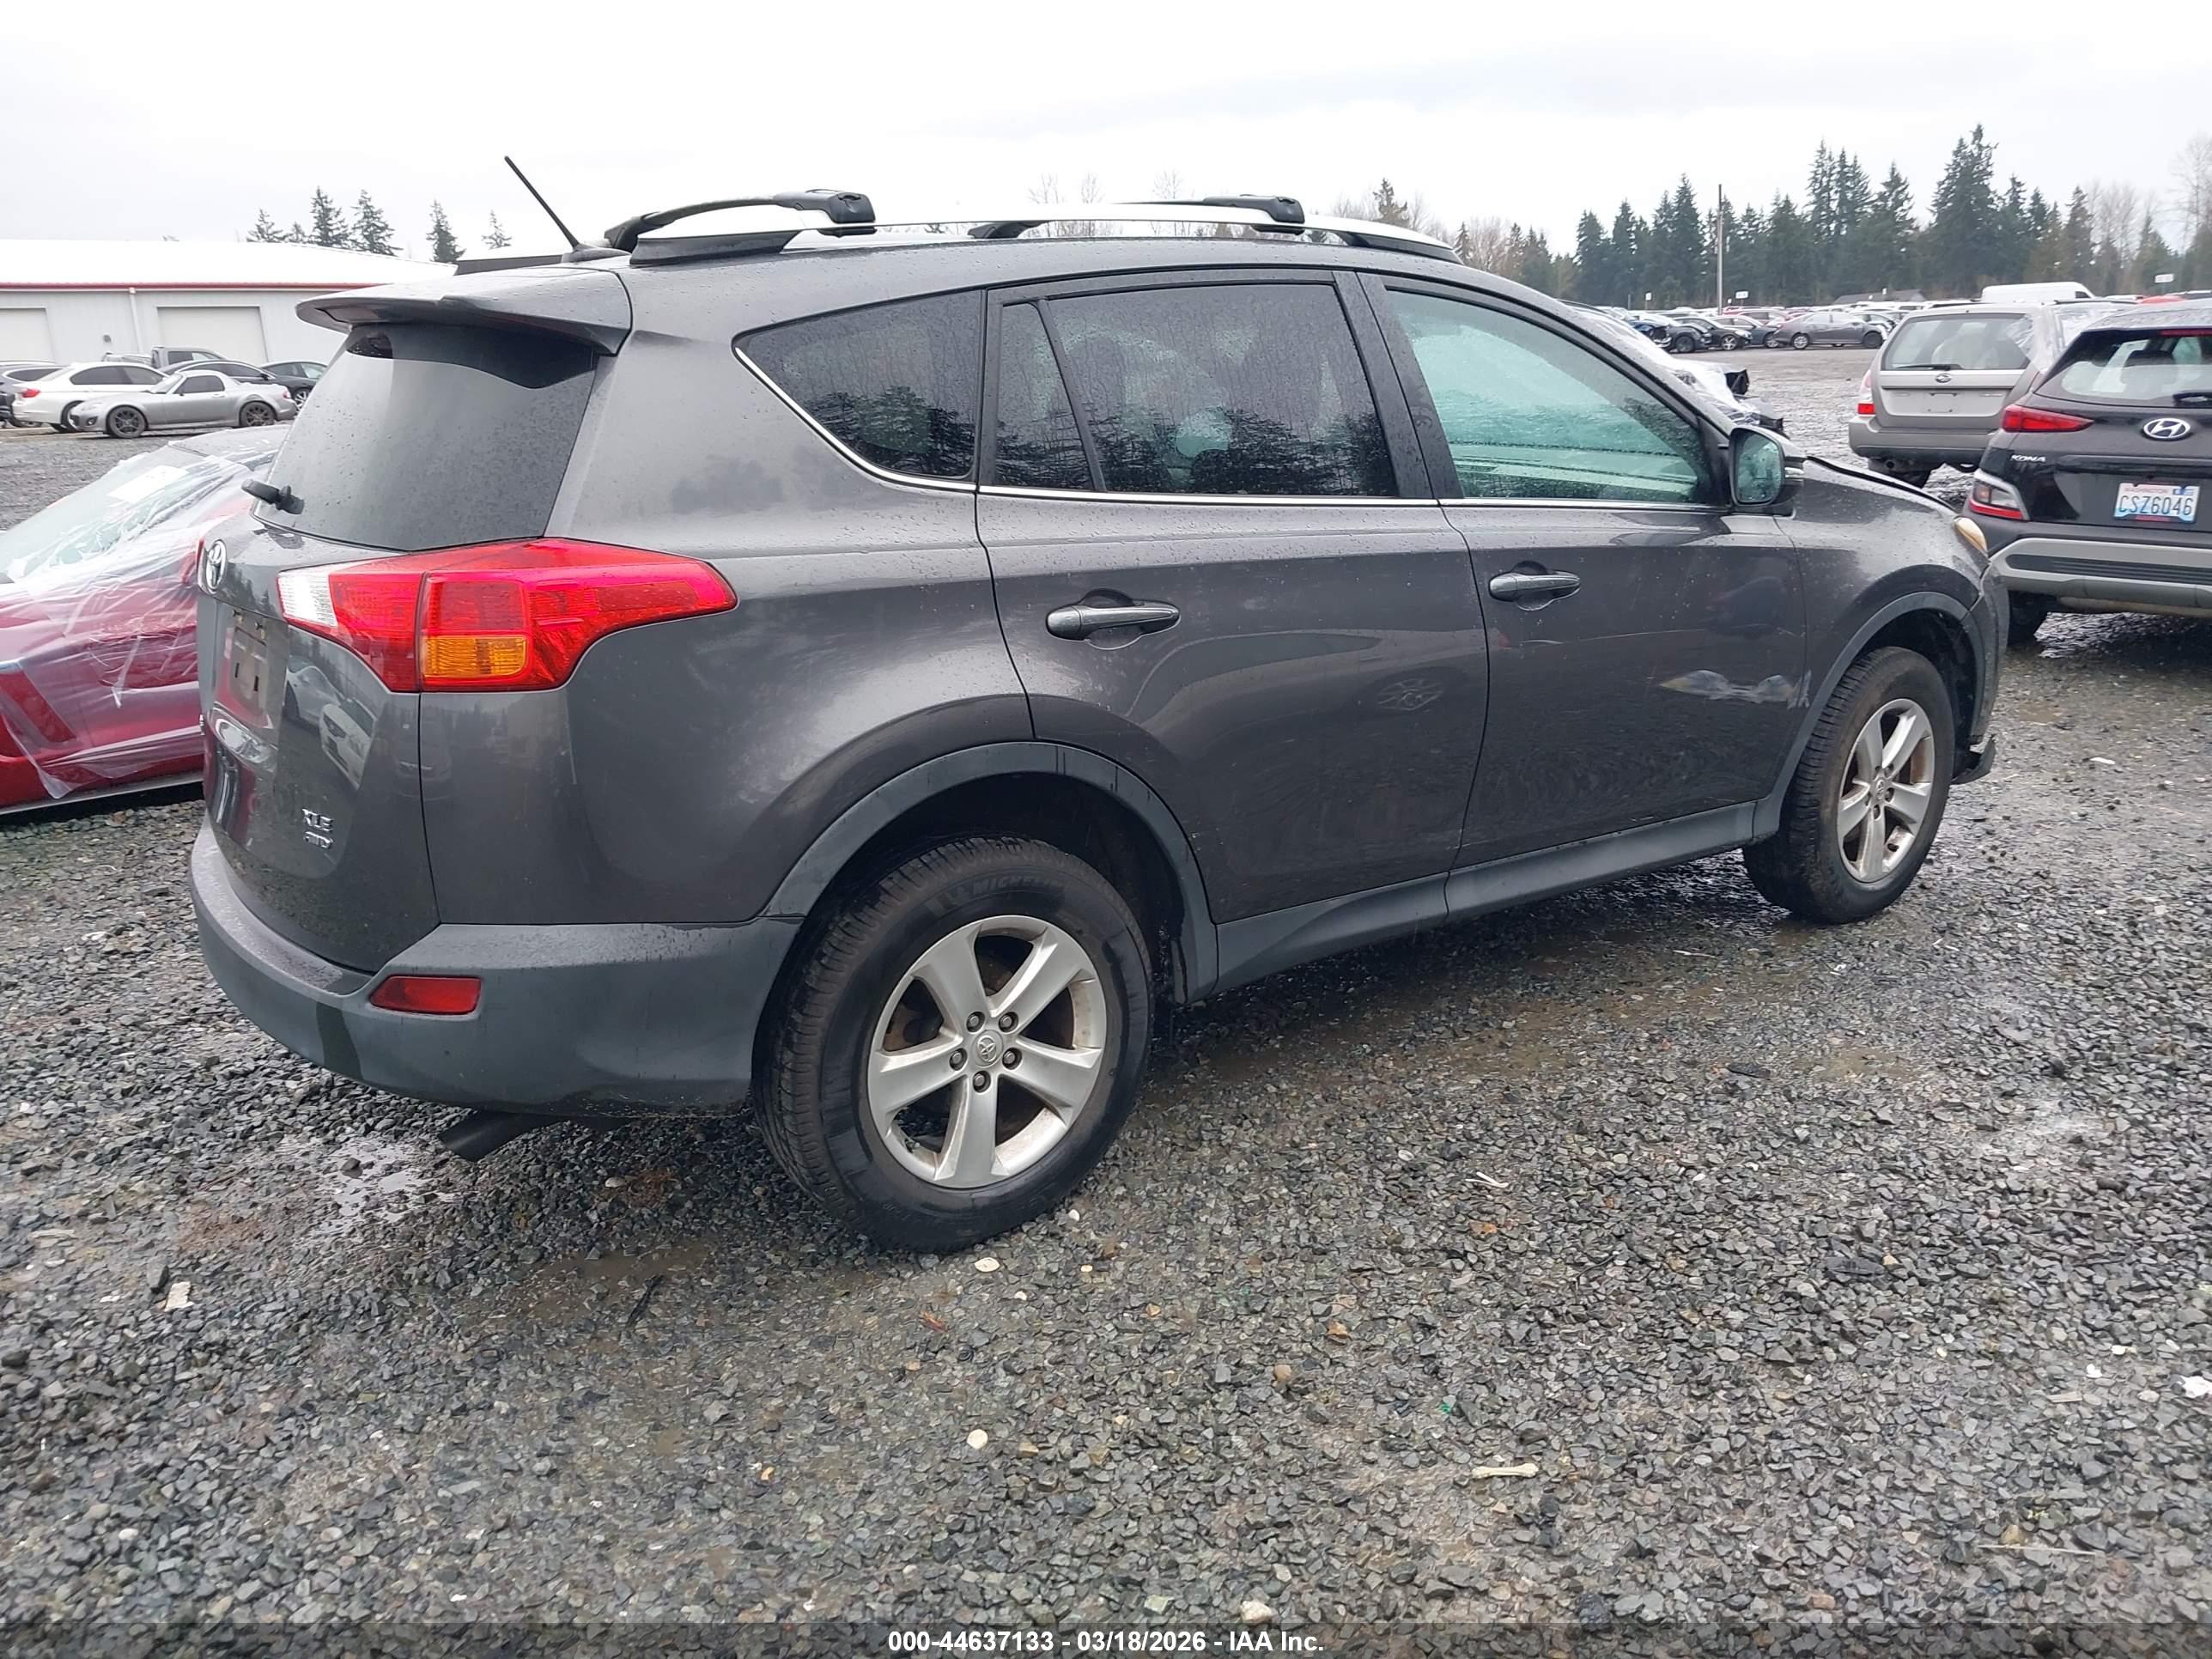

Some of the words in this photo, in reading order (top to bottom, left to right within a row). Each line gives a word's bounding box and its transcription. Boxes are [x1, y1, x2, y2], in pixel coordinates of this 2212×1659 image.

[2009, 454, 2045, 463] KONA
[2118, 495, 2193, 516] CSZ6046
[301, 808, 332, 831] XLE
